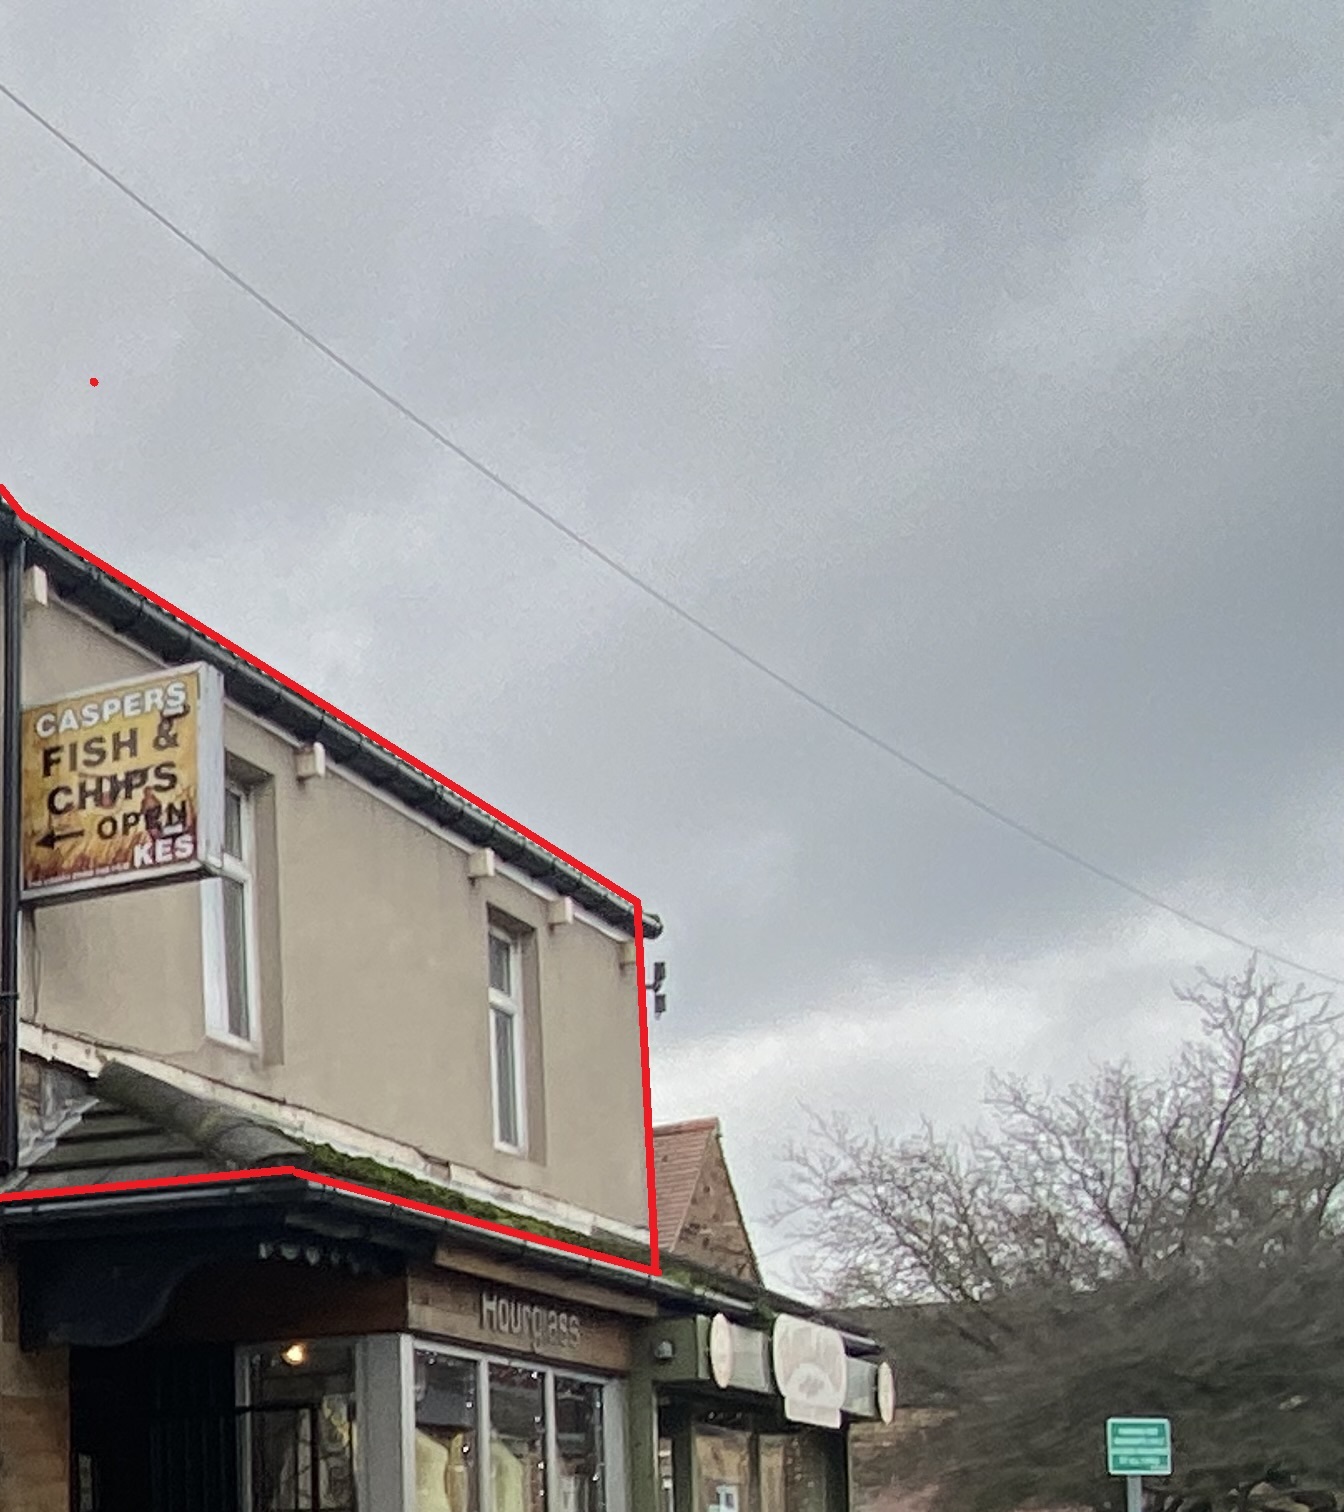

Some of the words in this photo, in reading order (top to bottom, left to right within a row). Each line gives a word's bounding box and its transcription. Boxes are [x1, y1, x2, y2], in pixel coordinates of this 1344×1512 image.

[36, 682, 187, 738] CASPERS
[42, 728, 138, 778] FISH
[153, 703, 191, 750] &
[47, 761, 178, 815] CHIPS
[481, 1292, 580, 1354] Hourglass
